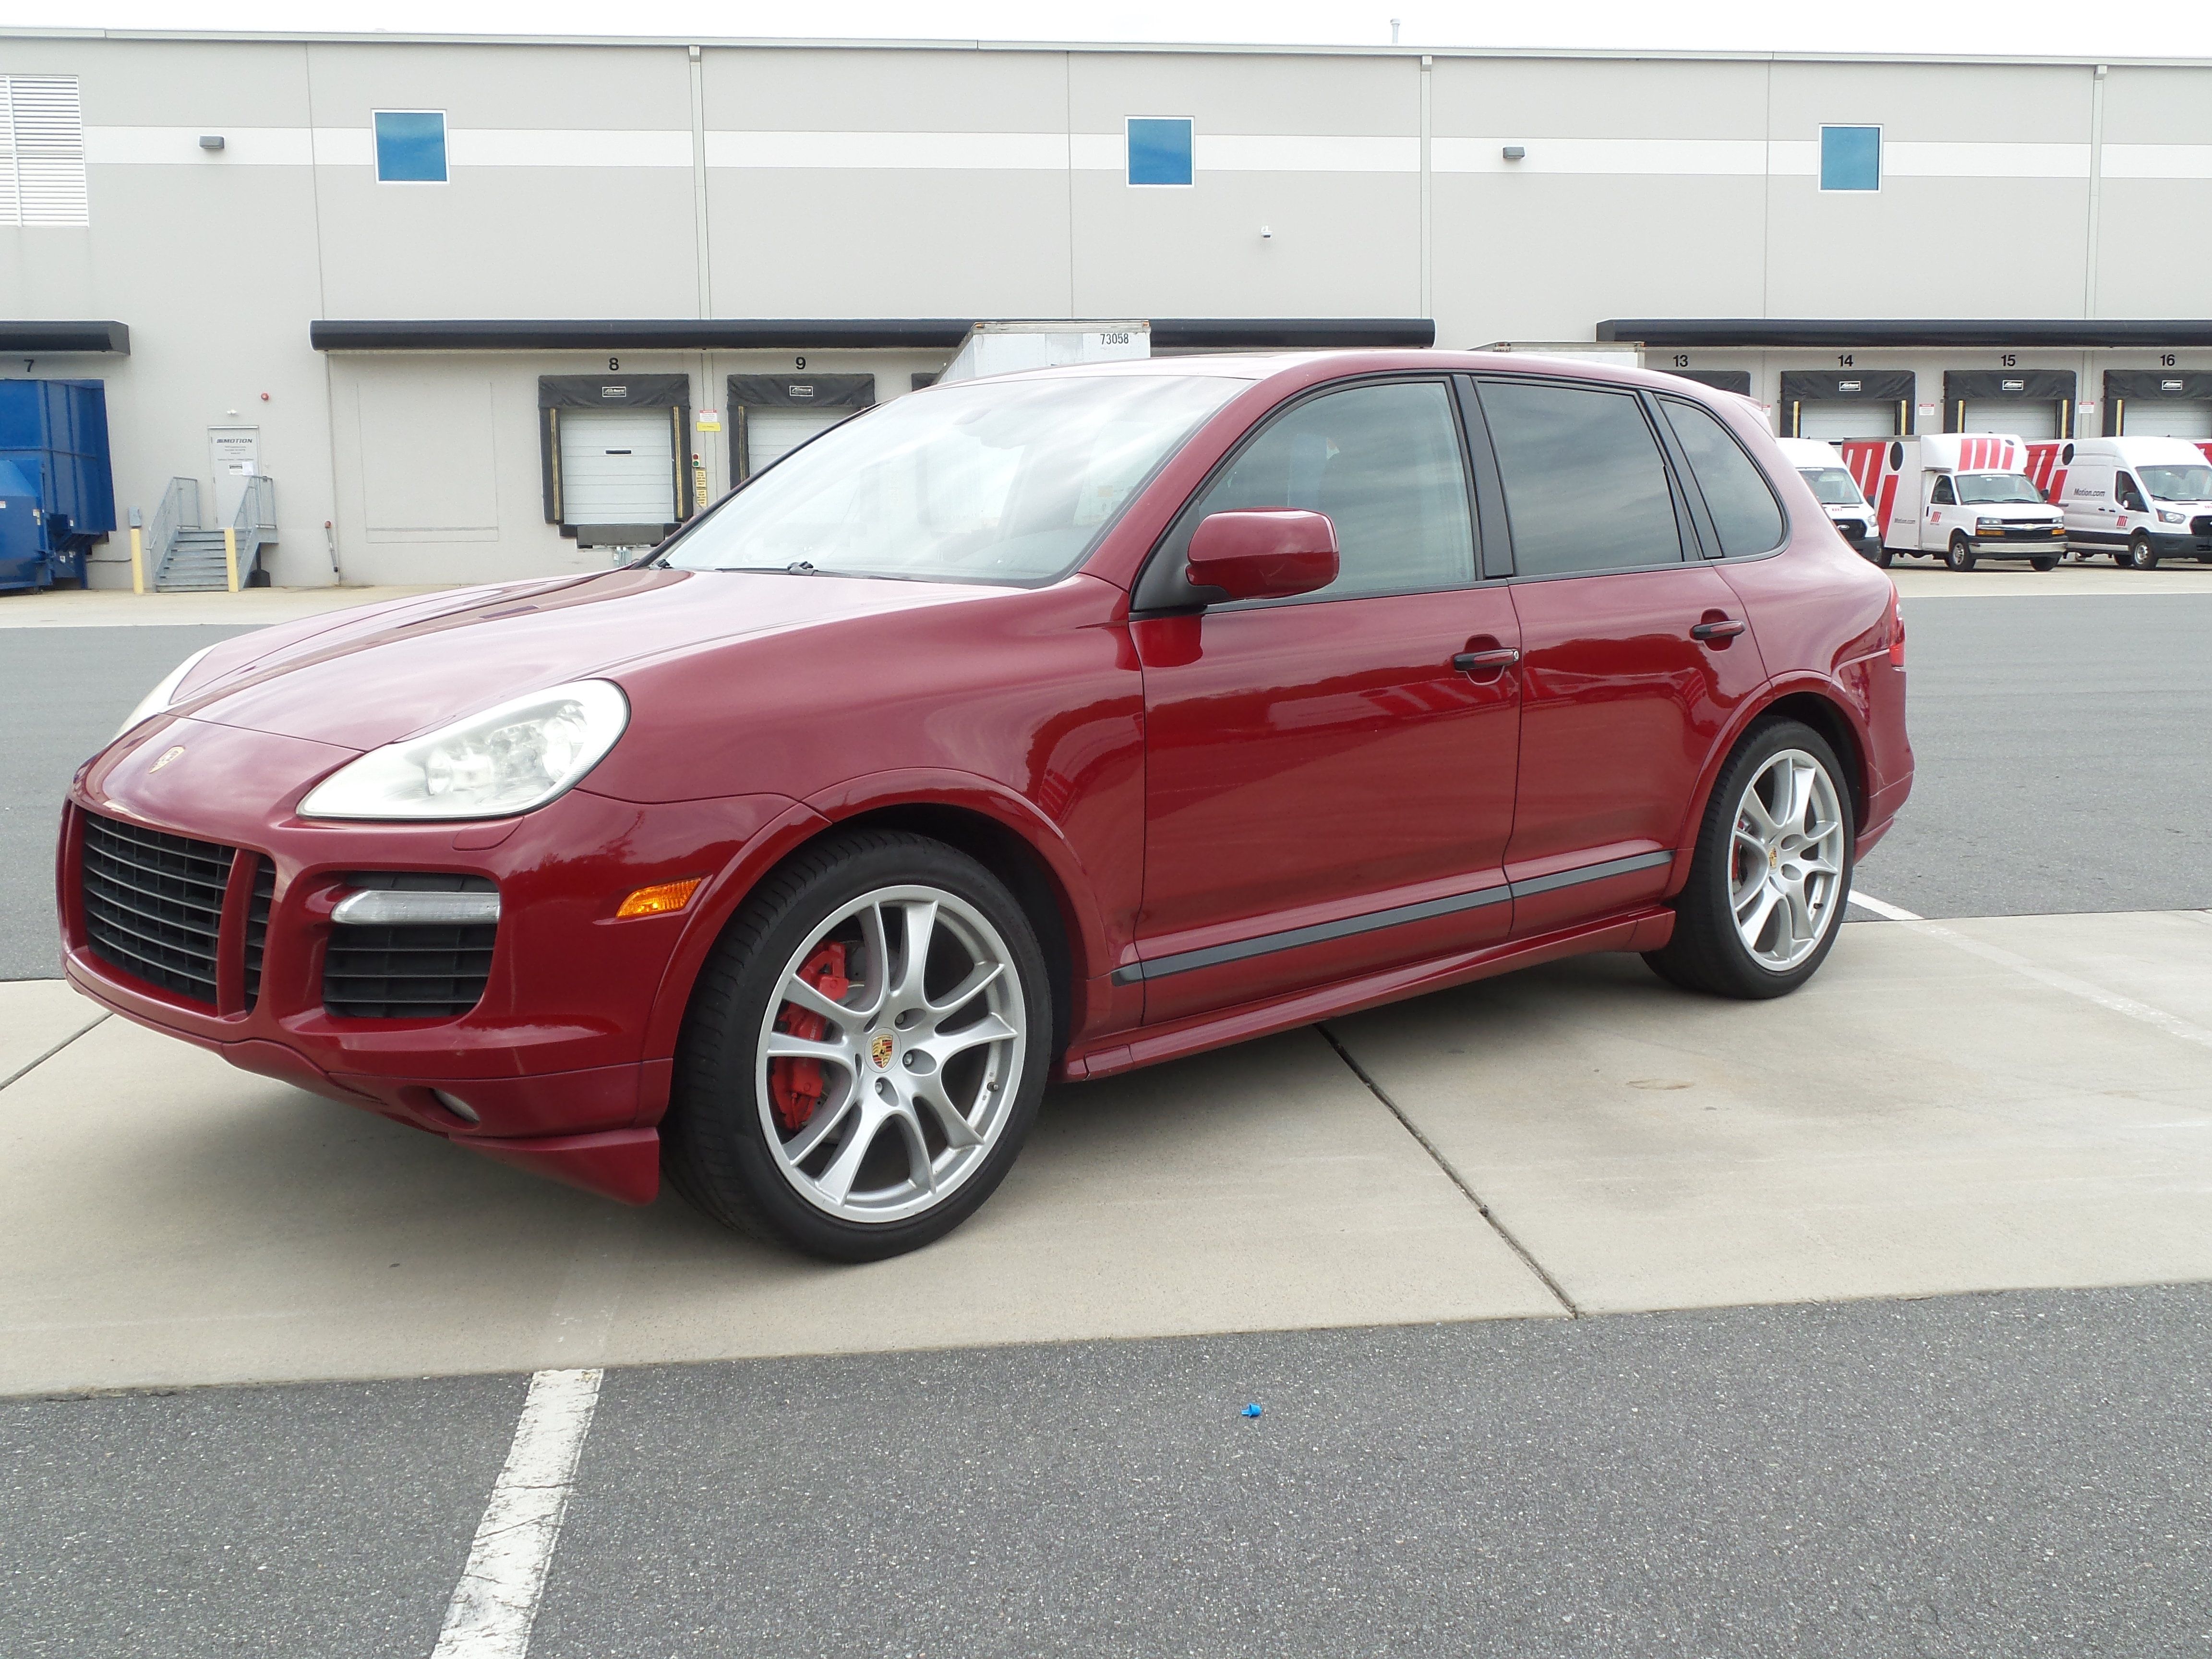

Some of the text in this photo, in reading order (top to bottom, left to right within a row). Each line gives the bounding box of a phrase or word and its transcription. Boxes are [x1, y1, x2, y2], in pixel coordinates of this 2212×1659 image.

[1100, 333, 1129, 345] 73058
[24, 359, 34, 373] 7
[609, 358, 619, 371] 8
[796, 357, 805, 370] 9
[1673, 355, 1688, 367] 13
[1838, 355, 1853, 367] 14
[2001, 355, 2016, 366] 15
[2160, 354, 2175, 366] 16
[2074, 488, 2105, 497] Motion.com
